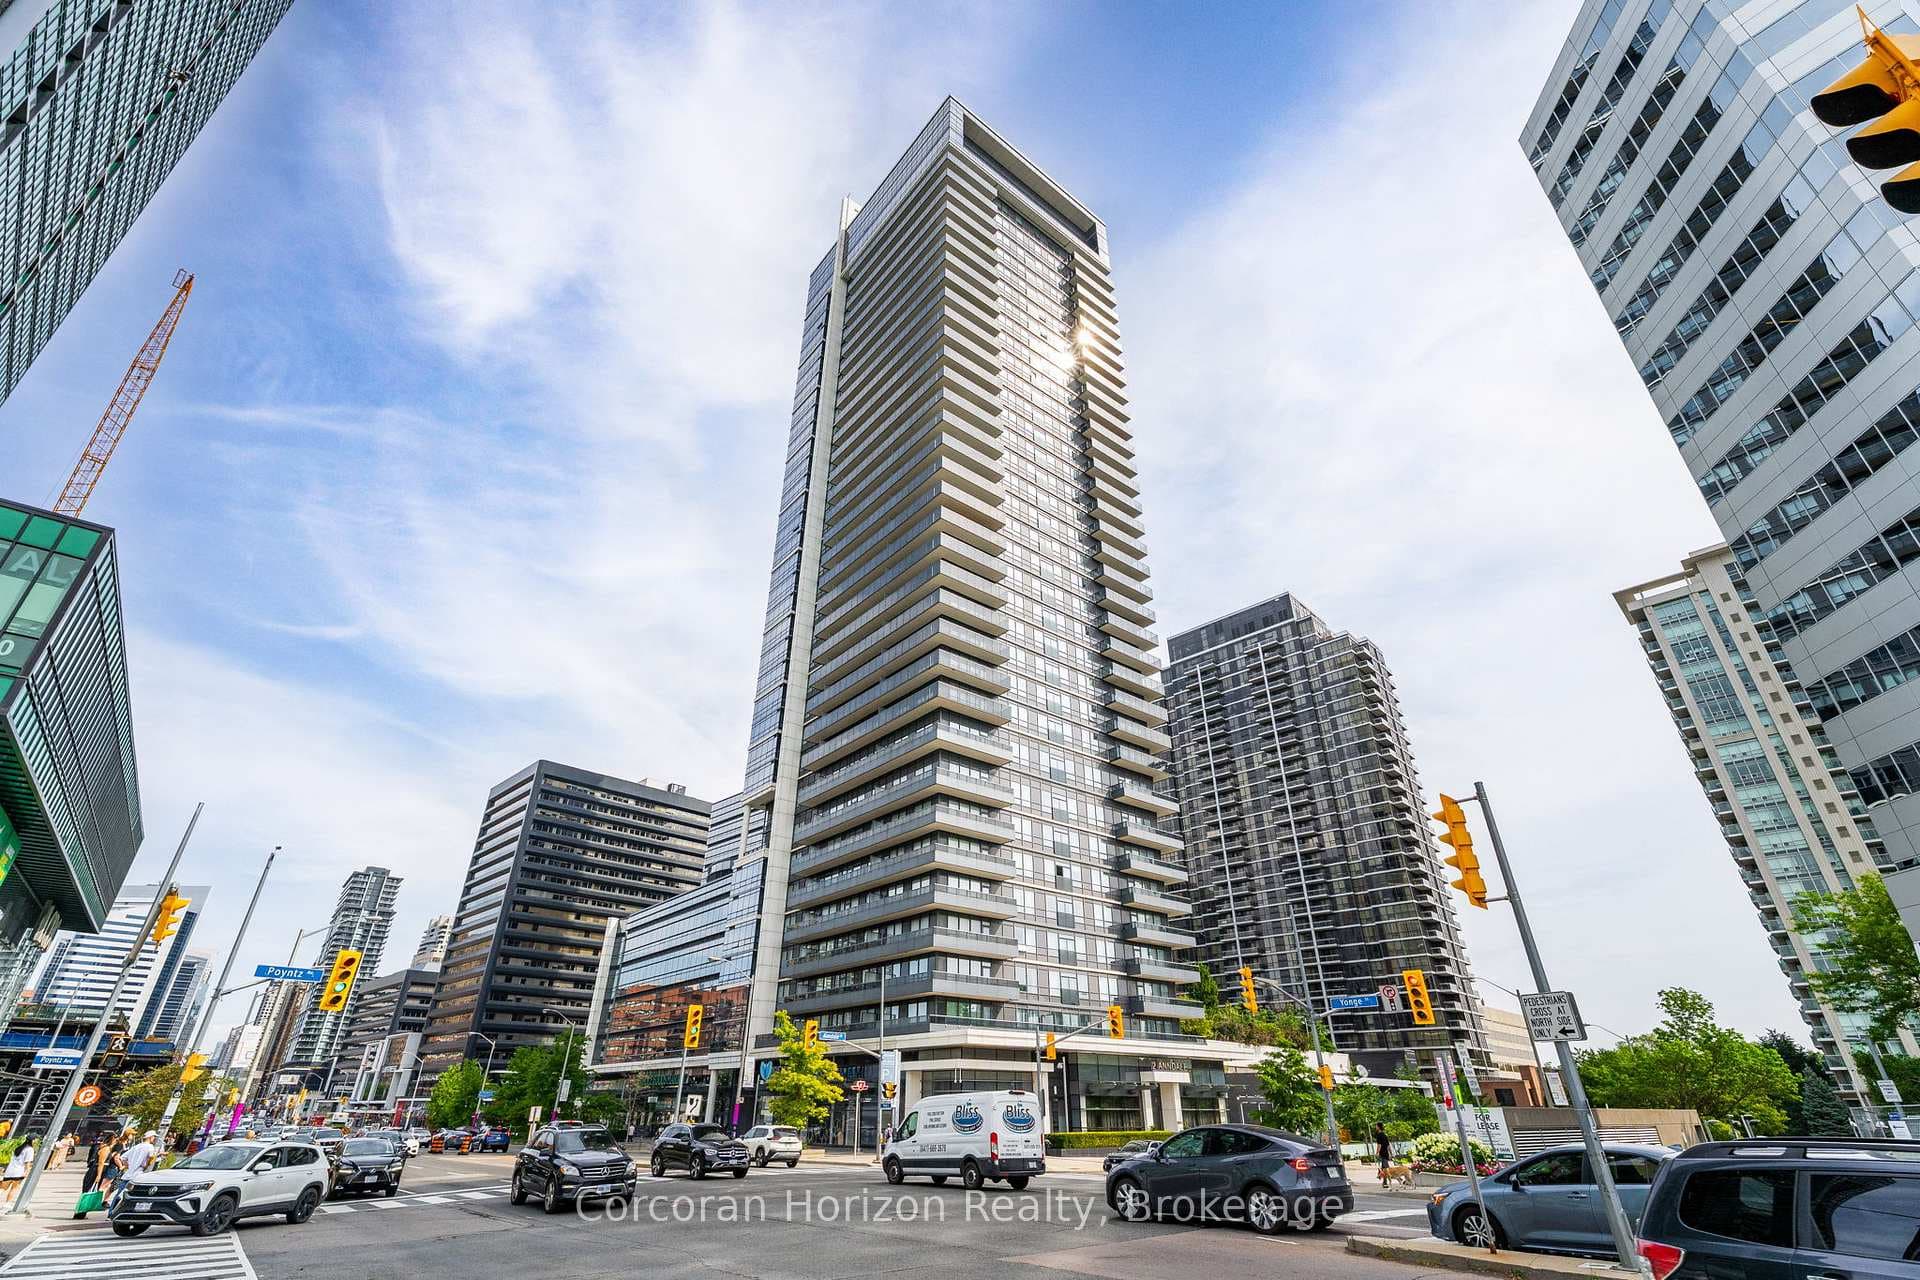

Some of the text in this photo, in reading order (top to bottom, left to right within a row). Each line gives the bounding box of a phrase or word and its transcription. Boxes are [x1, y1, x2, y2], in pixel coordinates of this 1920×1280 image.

[267, 967, 303, 979] Poyntz
[1340, 999, 1363, 1008] Yonge
[1523, 995, 1567, 1007] PEDESTRIANS
[1530, 1006, 1566, 1017] CROSS AT
[1530, 1016, 1573, 1027] NORTH SIDE
[1533, 1028, 1552, 1038] ONLY
[40, 1056, 63, 1064] Poyntz
[955, 1105, 979, 1119] Bliss
[1006, 1104, 1030, 1118] Bliss
[1475, 1113, 1491, 1121] FOR
[1476, 1122, 1500, 1131] LEASE
